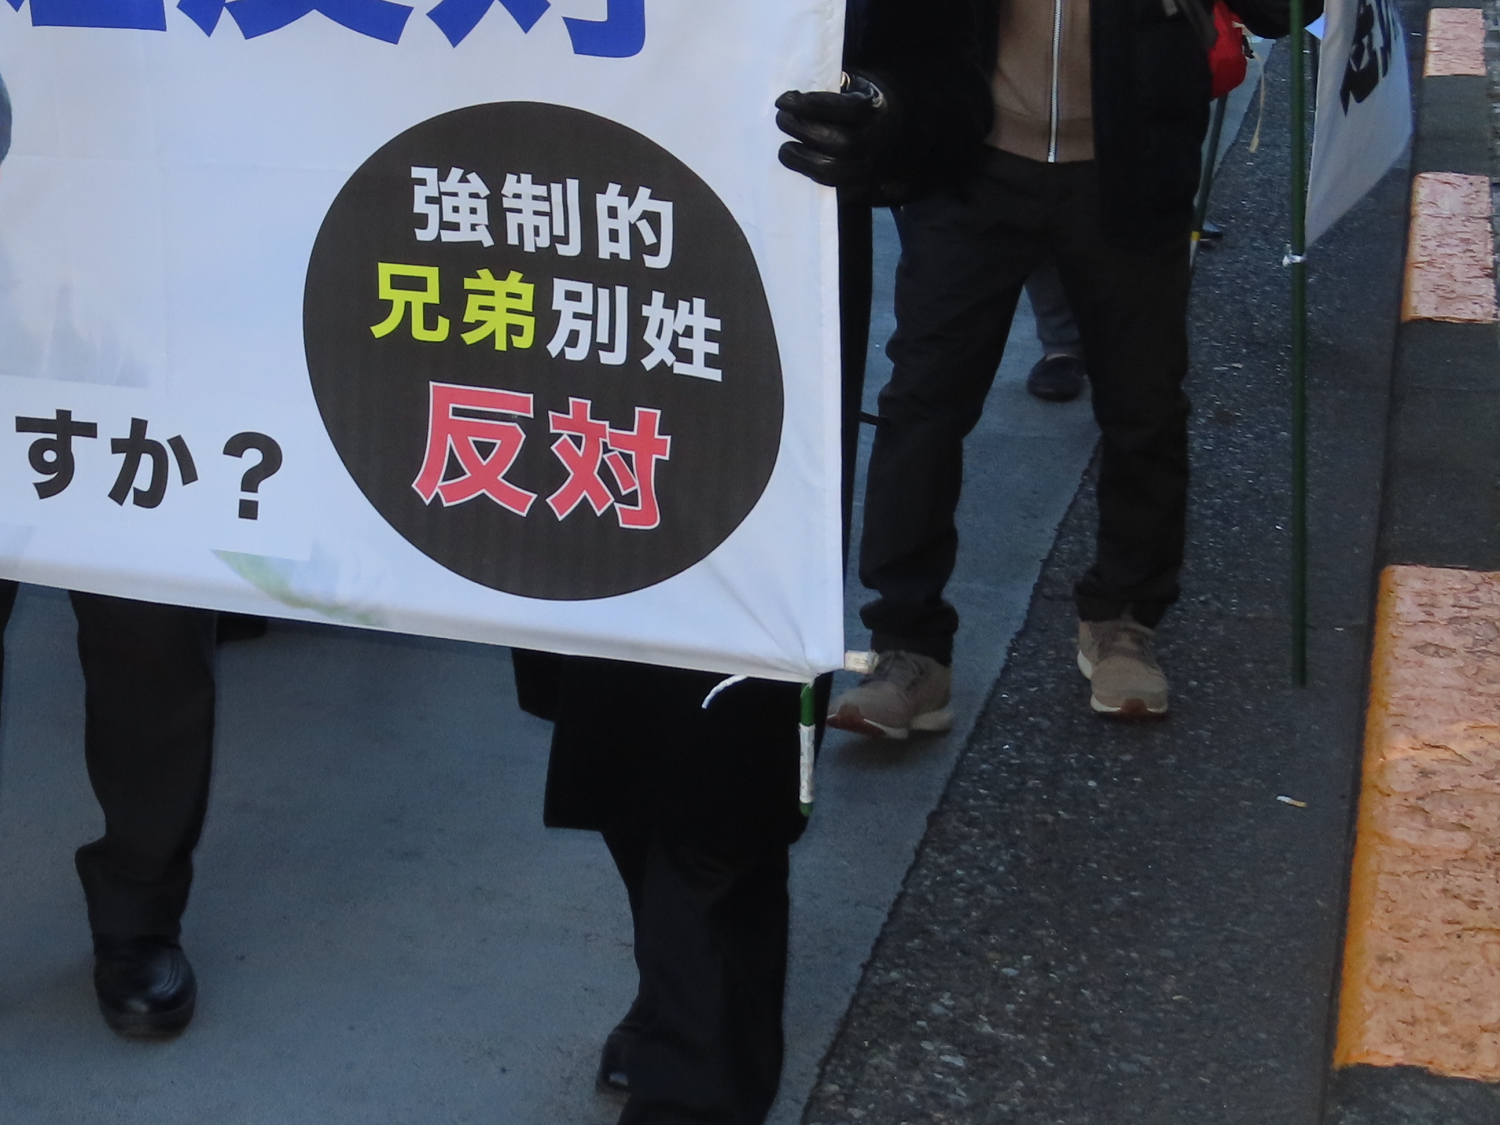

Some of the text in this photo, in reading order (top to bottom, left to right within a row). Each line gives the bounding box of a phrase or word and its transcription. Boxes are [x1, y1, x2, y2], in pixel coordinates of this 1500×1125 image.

[410, 166, 676, 271] 強制的
[369, 262, 724, 383] 兄弟別姓
[412, 379, 672, 531] 反対
